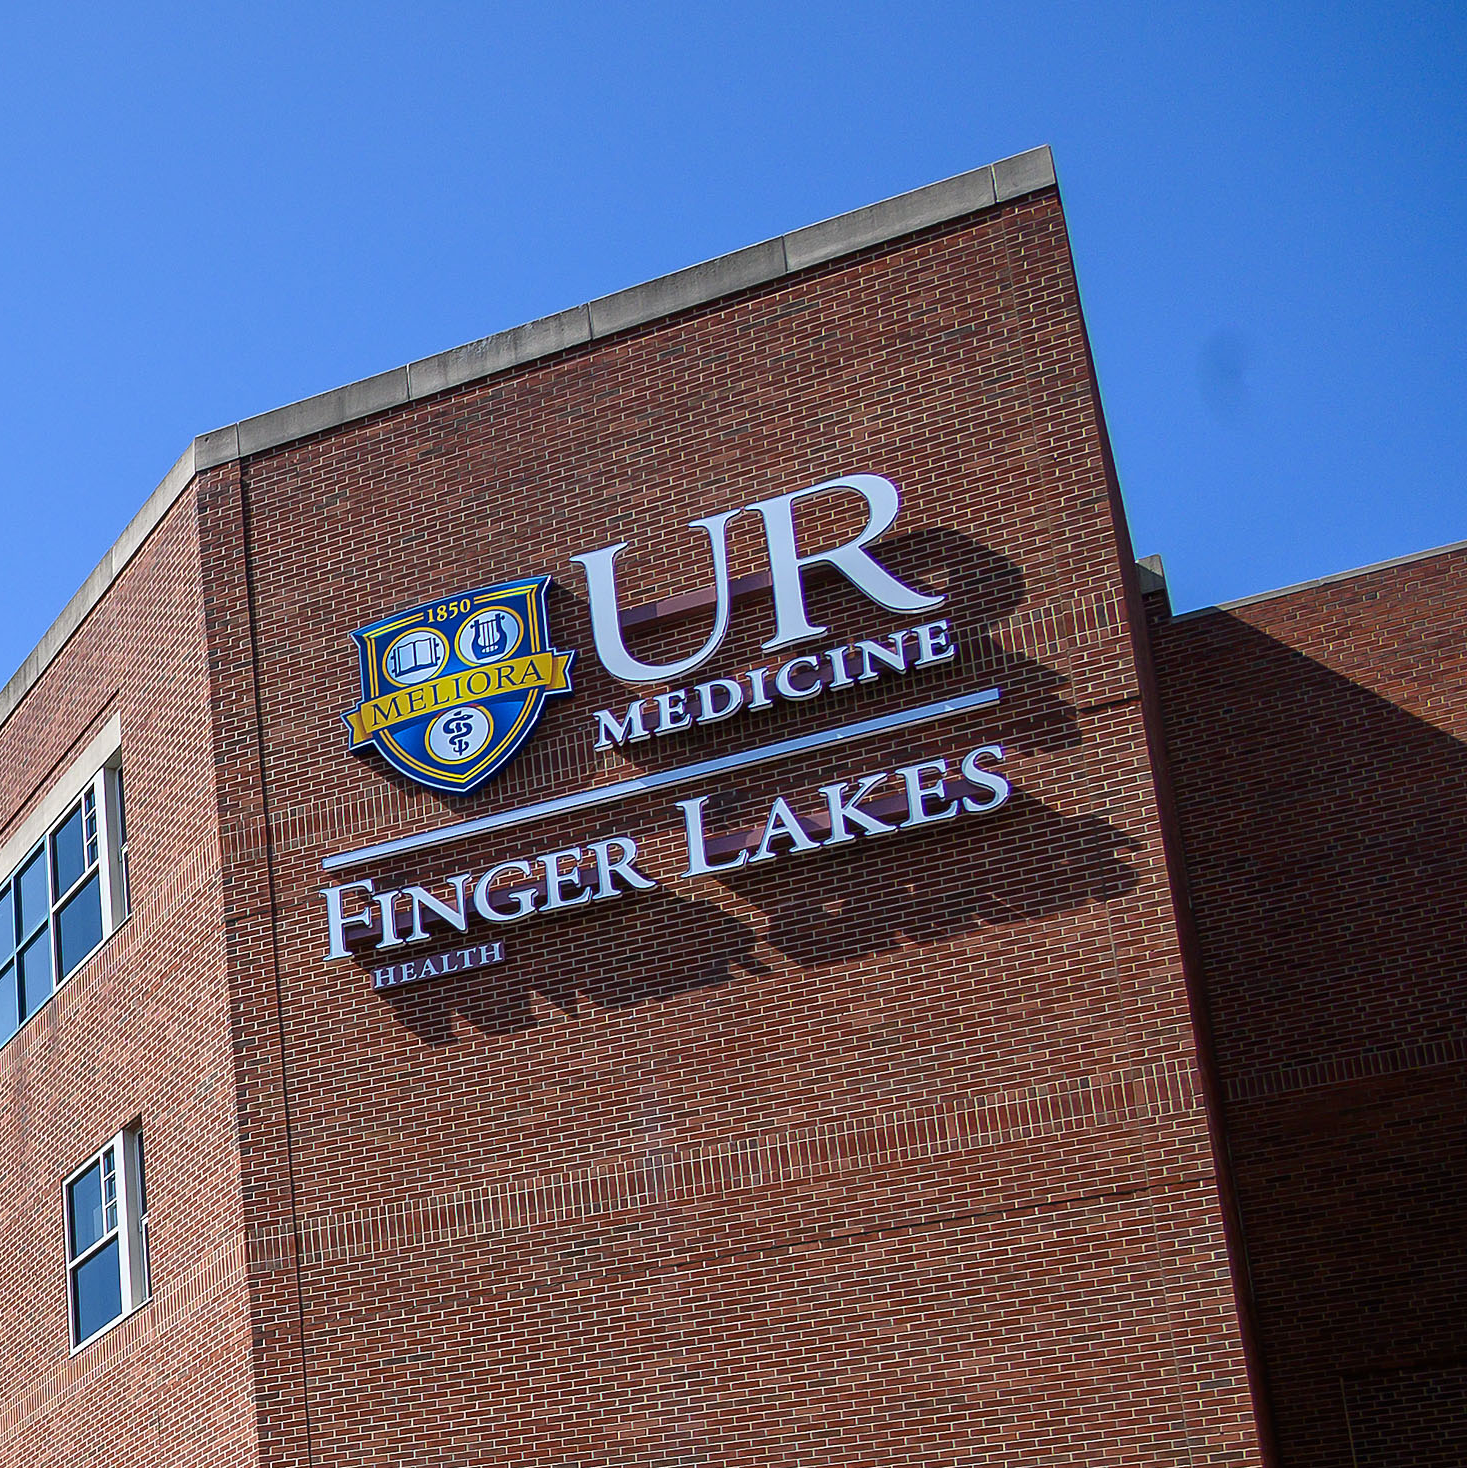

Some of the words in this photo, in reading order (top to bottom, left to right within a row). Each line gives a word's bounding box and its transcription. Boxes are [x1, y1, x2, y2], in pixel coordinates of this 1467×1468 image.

[426, 598, 471, 624] 1850
[570, 472, 946, 683] UR
[370, 659, 546, 727] MELIORA
[593, 619, 956, 752] MEDICINE
[319, 838, 656, 962] FINGER
[675, 743, 1013, 879] LAKES
[372, 941, 505, 990] HEALTH
